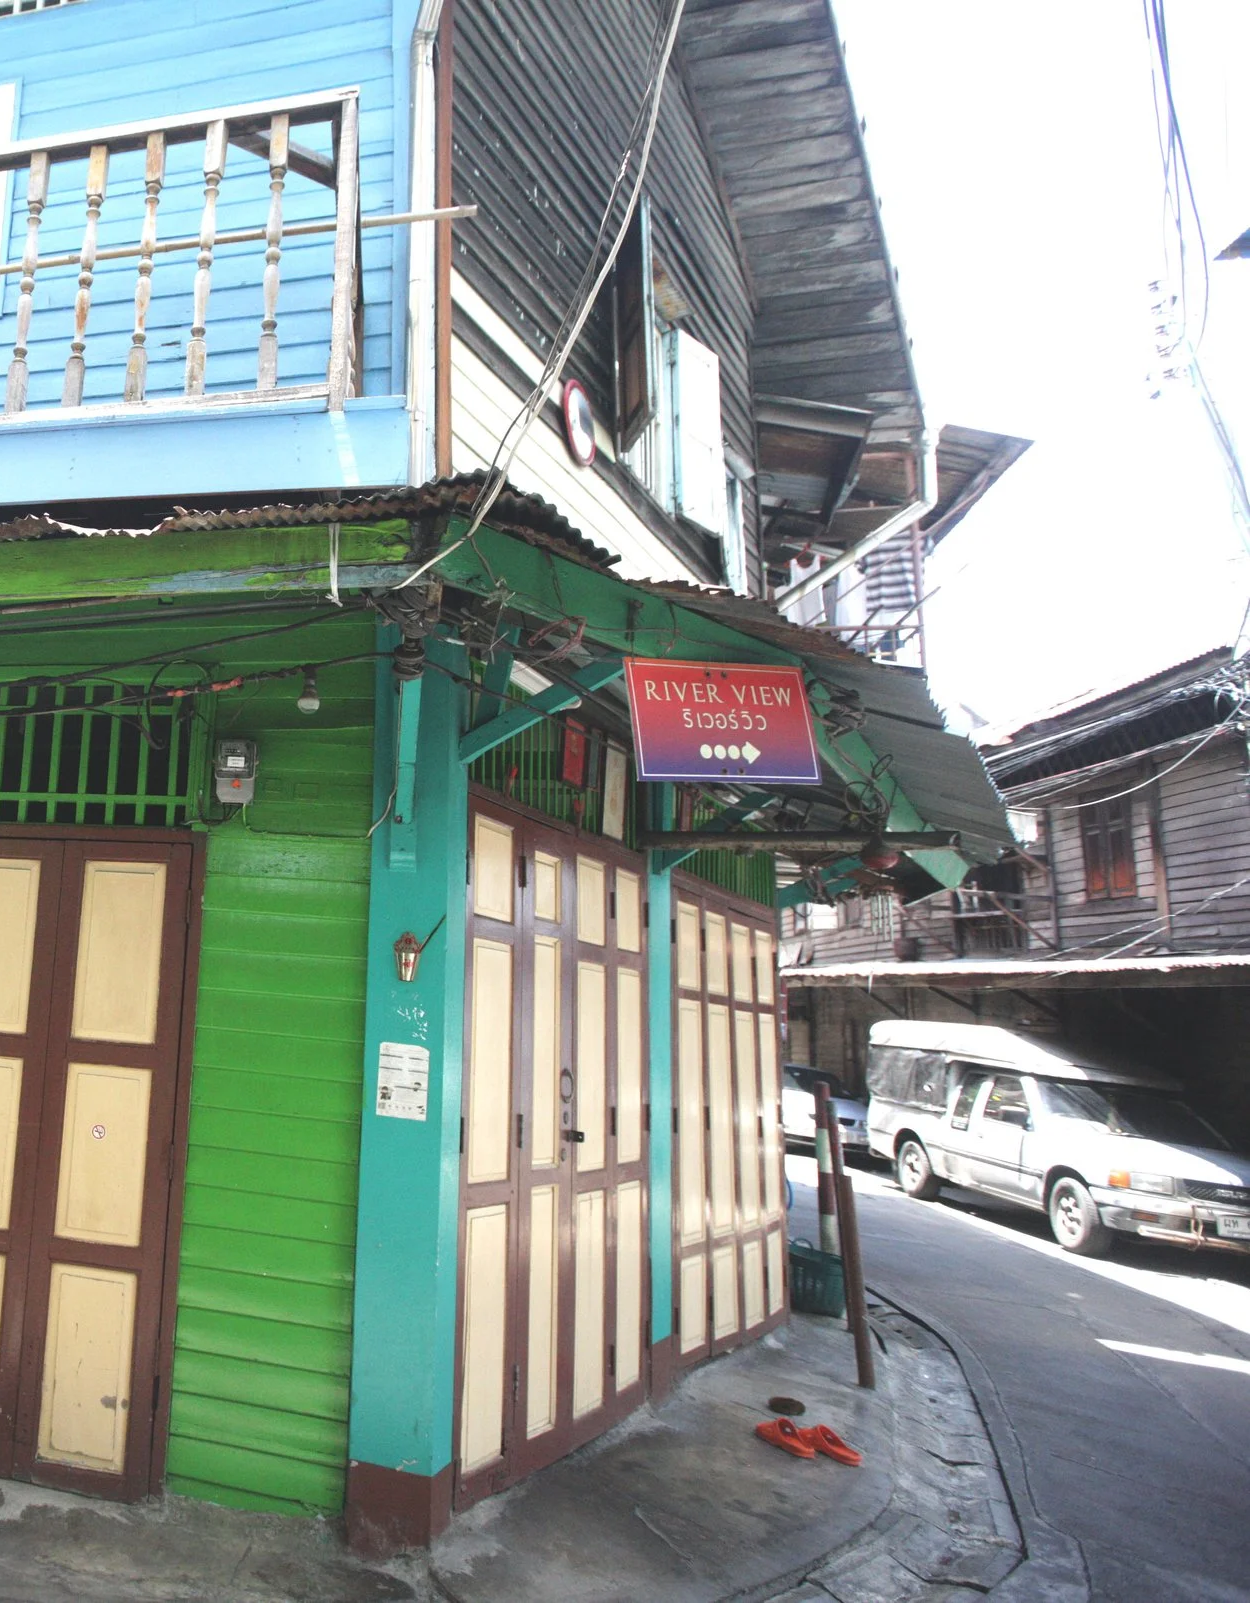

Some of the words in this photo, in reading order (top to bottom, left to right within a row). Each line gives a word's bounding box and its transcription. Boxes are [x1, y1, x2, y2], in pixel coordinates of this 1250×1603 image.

[644, 680, 725, 704] RIVER
[731, 684, 791, 707] VIEW
[682, 708, 767, 731] ริเวอร์วิว
